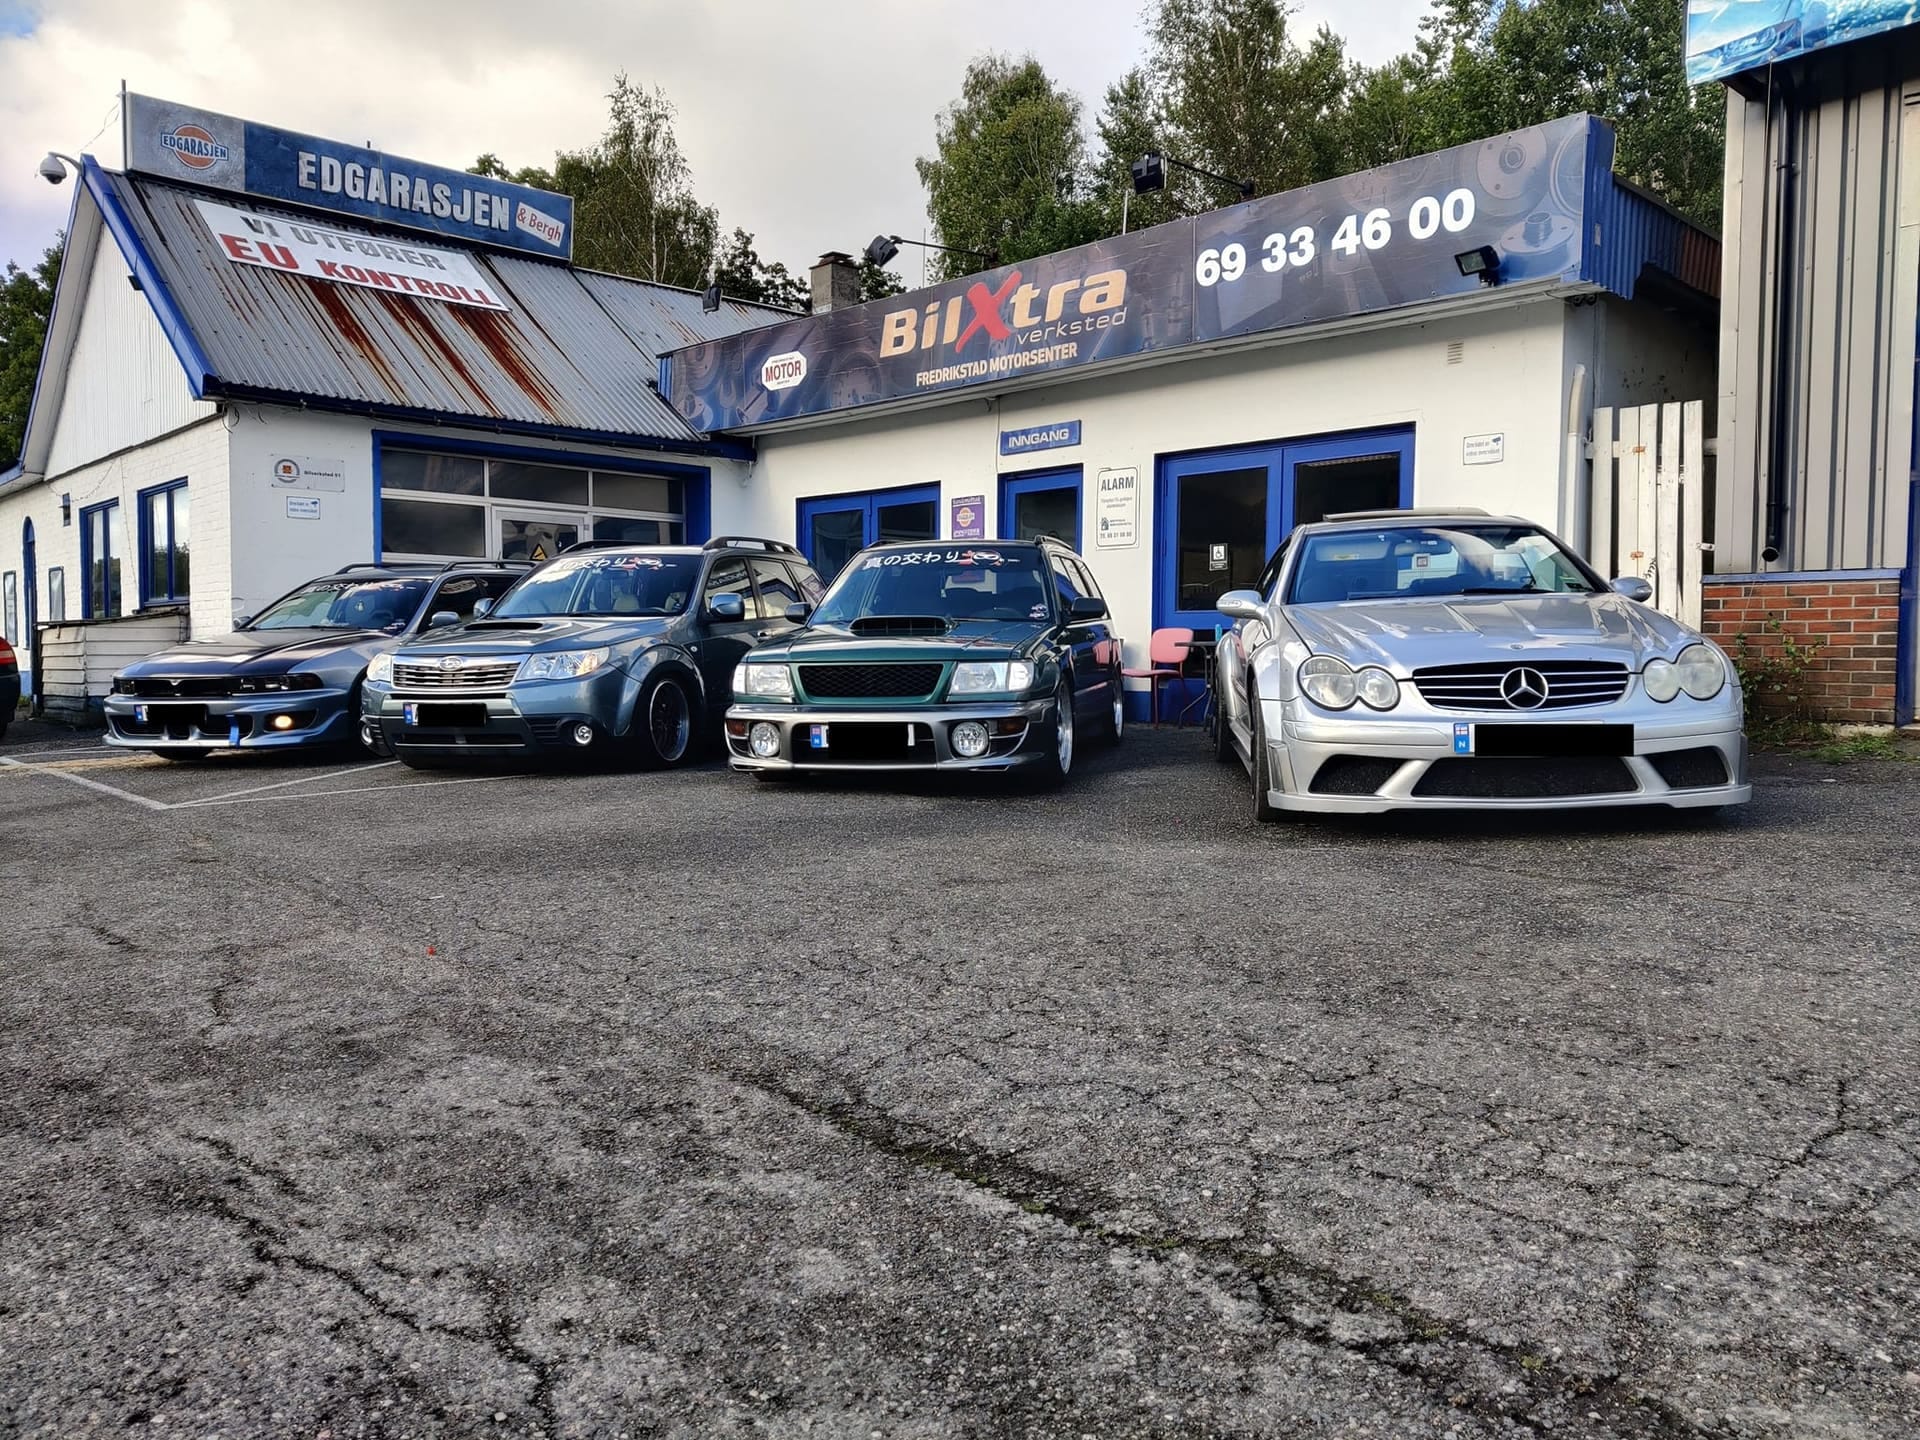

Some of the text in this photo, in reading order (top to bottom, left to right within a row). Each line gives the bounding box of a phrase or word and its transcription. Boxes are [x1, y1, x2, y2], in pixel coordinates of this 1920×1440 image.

[162, 135, 227, 159] EDGARASJEN
[298, 151, 509, 231] EDGARASJEN
[240, 216, 447, 271] VI UTFØRER
[516, 207, 562, 242] & Bergh
[1195, 188, 1475, 287] 69 33 46 00
[219, 233, 502, 306] EU KONTROLL
[879, 270, 1127, 358] BilXtra
[1015, 307, 1128, 345] verksted
[765, 360, 802, 383] MOTOR
[916, 342, 1078, 387] FREDRIKSTAD MOTORSENTER
[1008, 428, 1070, 448] INNGANG
[1101, 476, 1134, 491] ALARM
